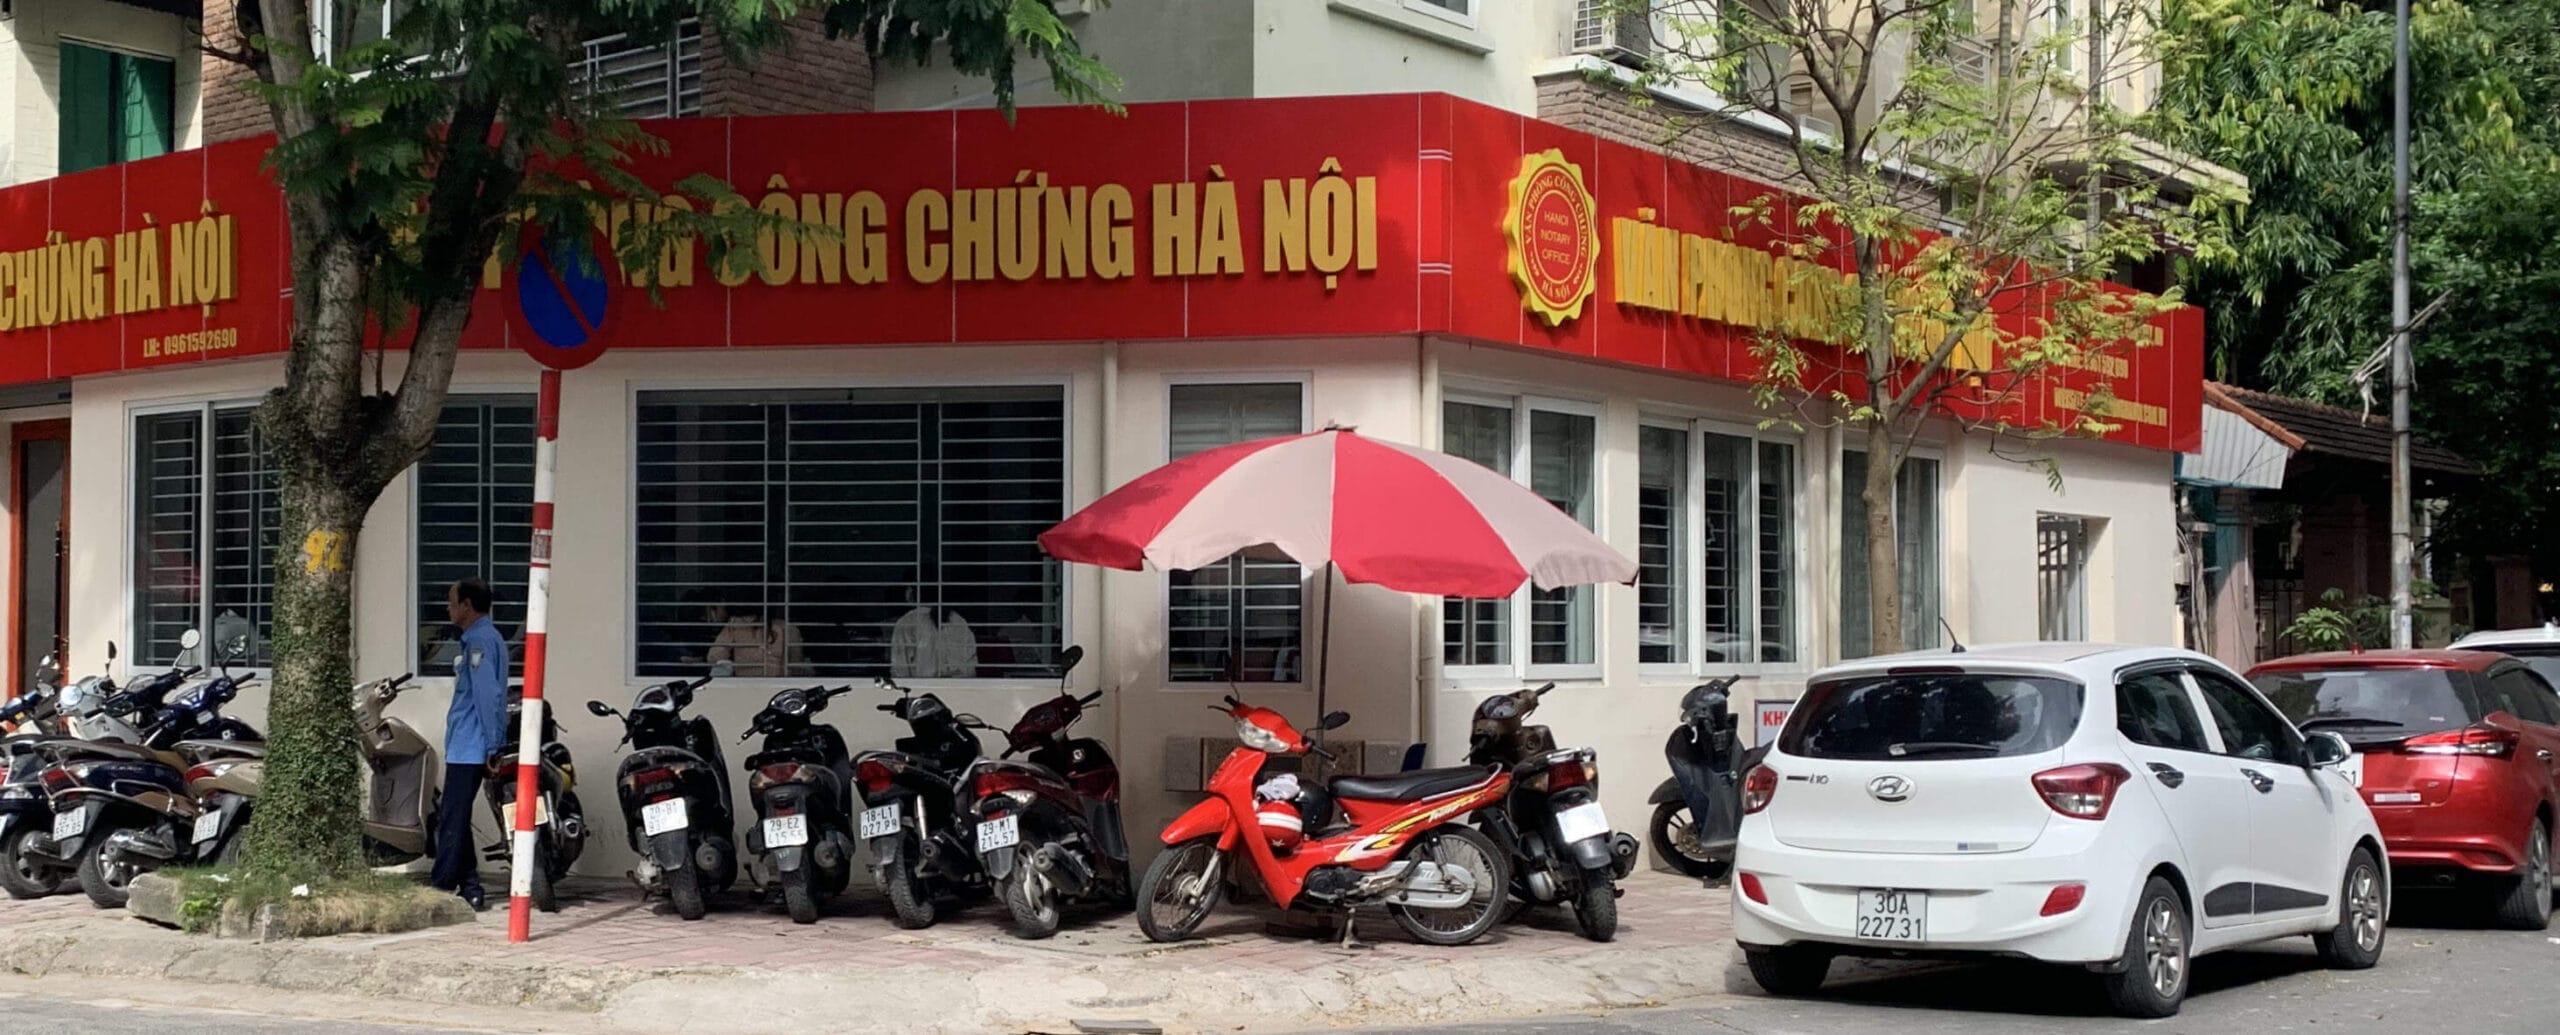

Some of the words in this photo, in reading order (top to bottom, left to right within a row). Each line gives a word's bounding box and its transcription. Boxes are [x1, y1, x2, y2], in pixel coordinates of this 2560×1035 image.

[905, 169, 1135, 283] CHỨNG
[1152, 164, 1245, 277] HÀ
[1262, 156, 1377, 289] NỘI
[1540, 229, 1571, 246] NOTARY
[114, 212, 162, 315] HÀ
[170, 199, 236, 318] NỘI
[1541, 248, 1572, 265] OFFICE
[164, 327, 238, 355] 0961592690
[1874, 893, 1909, 914] 30A
[1859, 916, 1922, 939] 227.31
